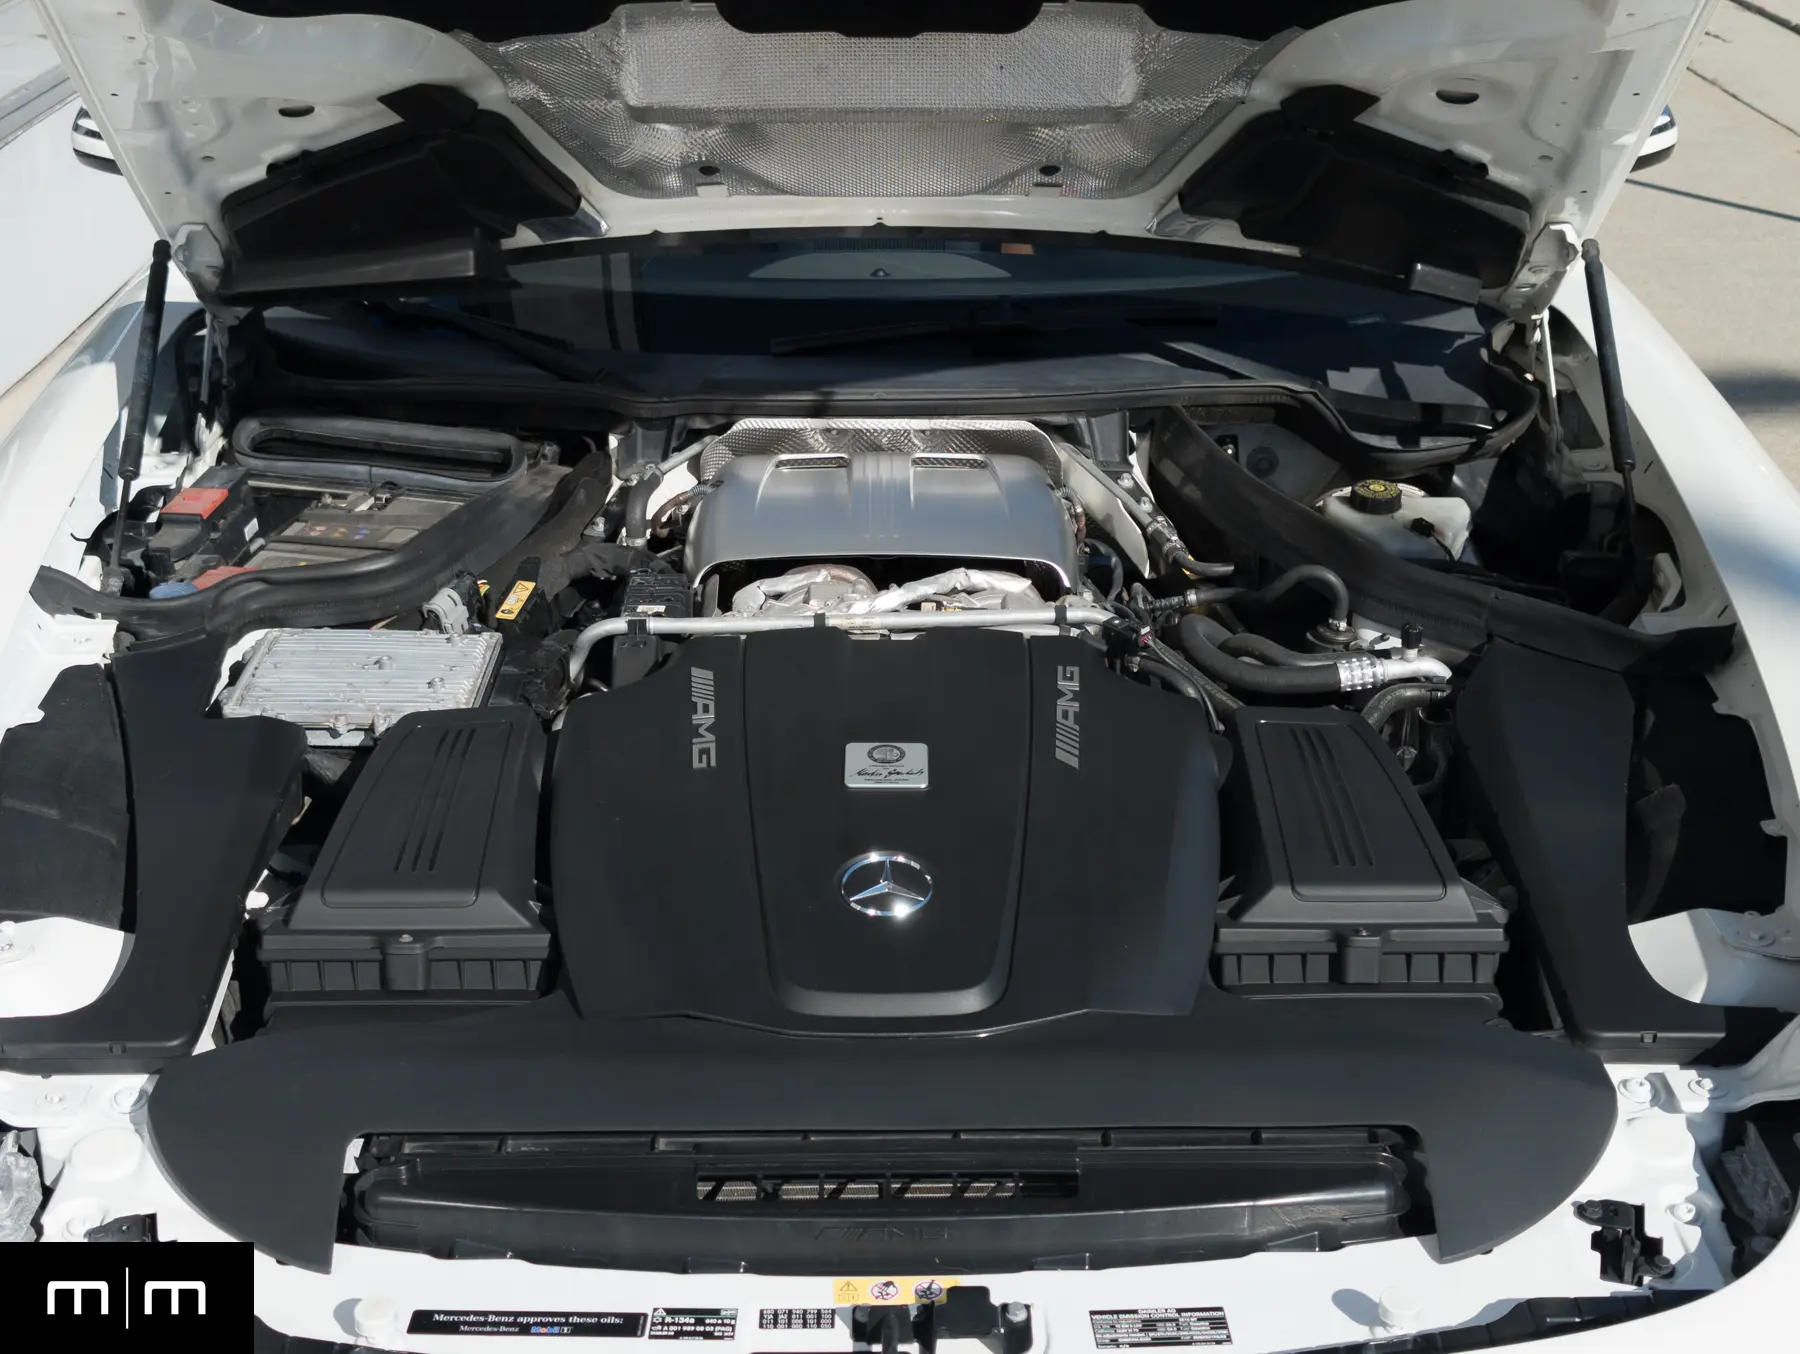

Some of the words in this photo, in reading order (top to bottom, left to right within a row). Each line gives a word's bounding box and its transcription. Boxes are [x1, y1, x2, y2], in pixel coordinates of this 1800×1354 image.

[1055, 665, 1080, 732] AMG
[691, 695, 716, 770] AMG
[433, 1313, 514, 1323] Mercedes-Benz
[517, 1315, 567, 1325] approves
[569, 1315, 598, 1323] these
[600, 1315, 624, 1325] oils:
[458, 1324, 519, 1333] Mercedes-Benz
[530, 1326, 560, 1334] Mobil
